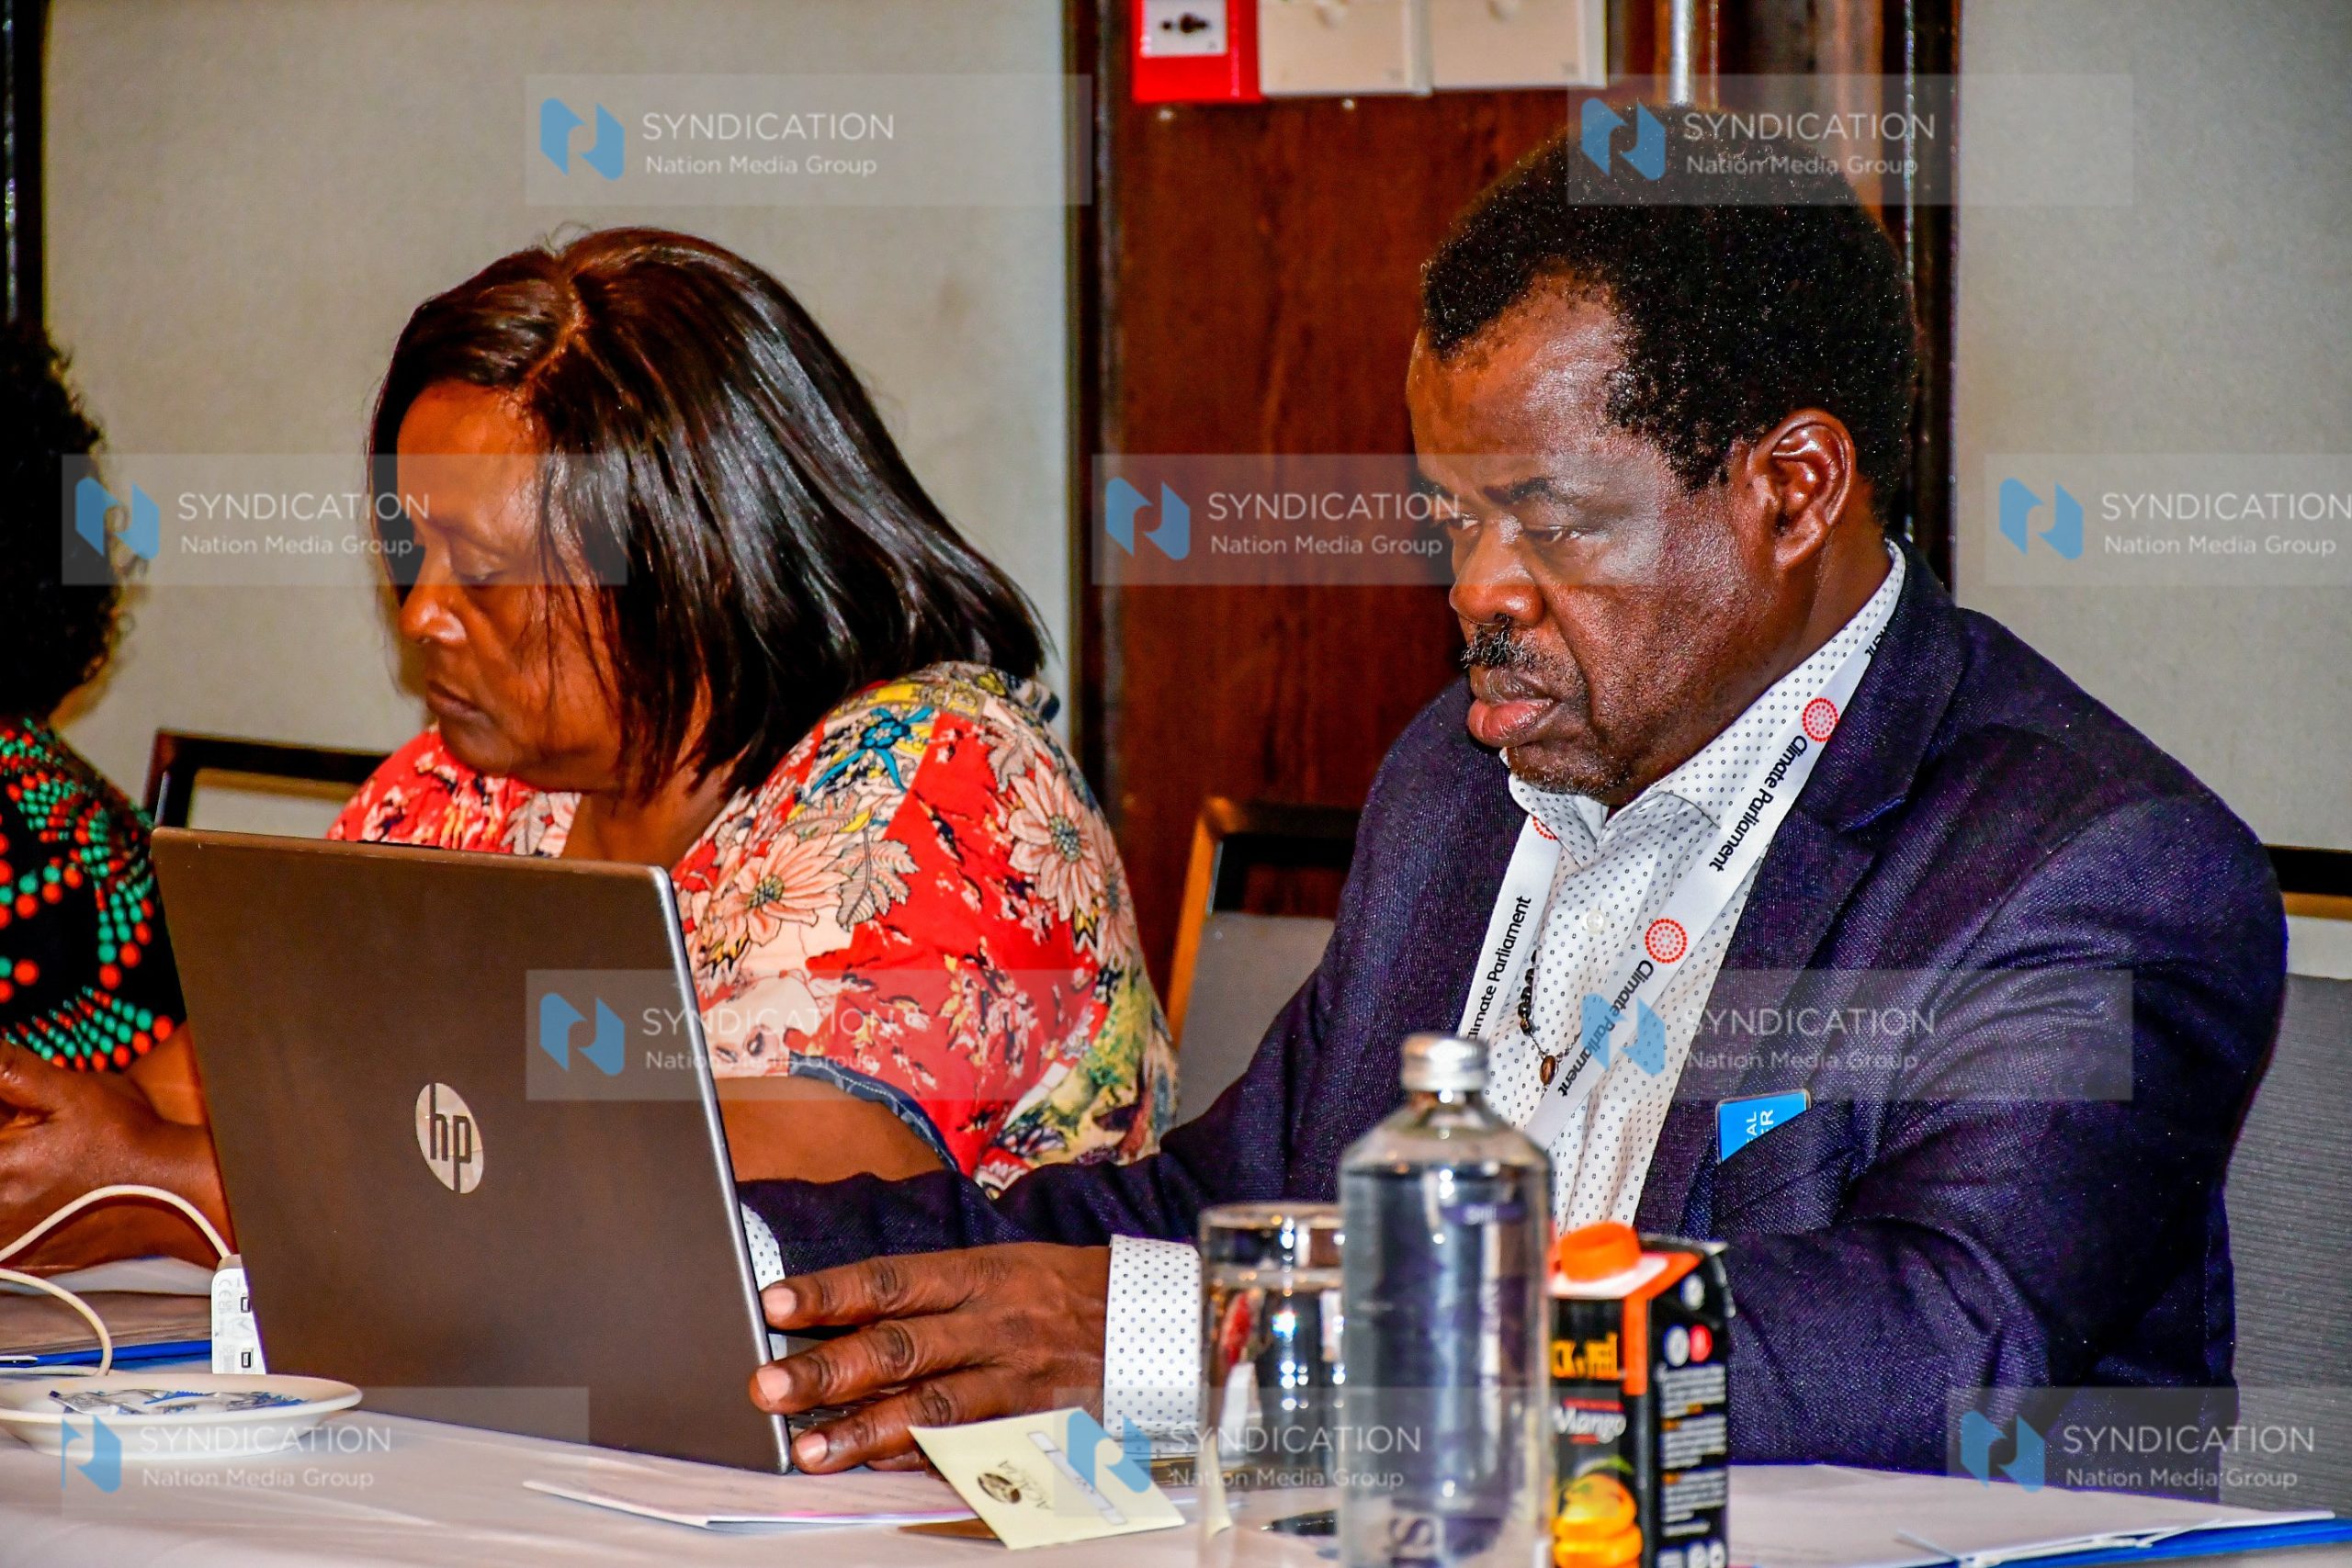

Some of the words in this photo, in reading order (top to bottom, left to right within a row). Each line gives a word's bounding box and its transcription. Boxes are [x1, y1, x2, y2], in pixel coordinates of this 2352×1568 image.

[1764, 735, 1808, 789] Climate
[1709, 788, 1774, 872] Parliament
[1487, 896, 1532, 982] Parliament
[1609, 960, 1655, 1018] Climate
[1557, 1015, 1616, 1097] Parliament
[428, 1083, 472, 1193] hp
